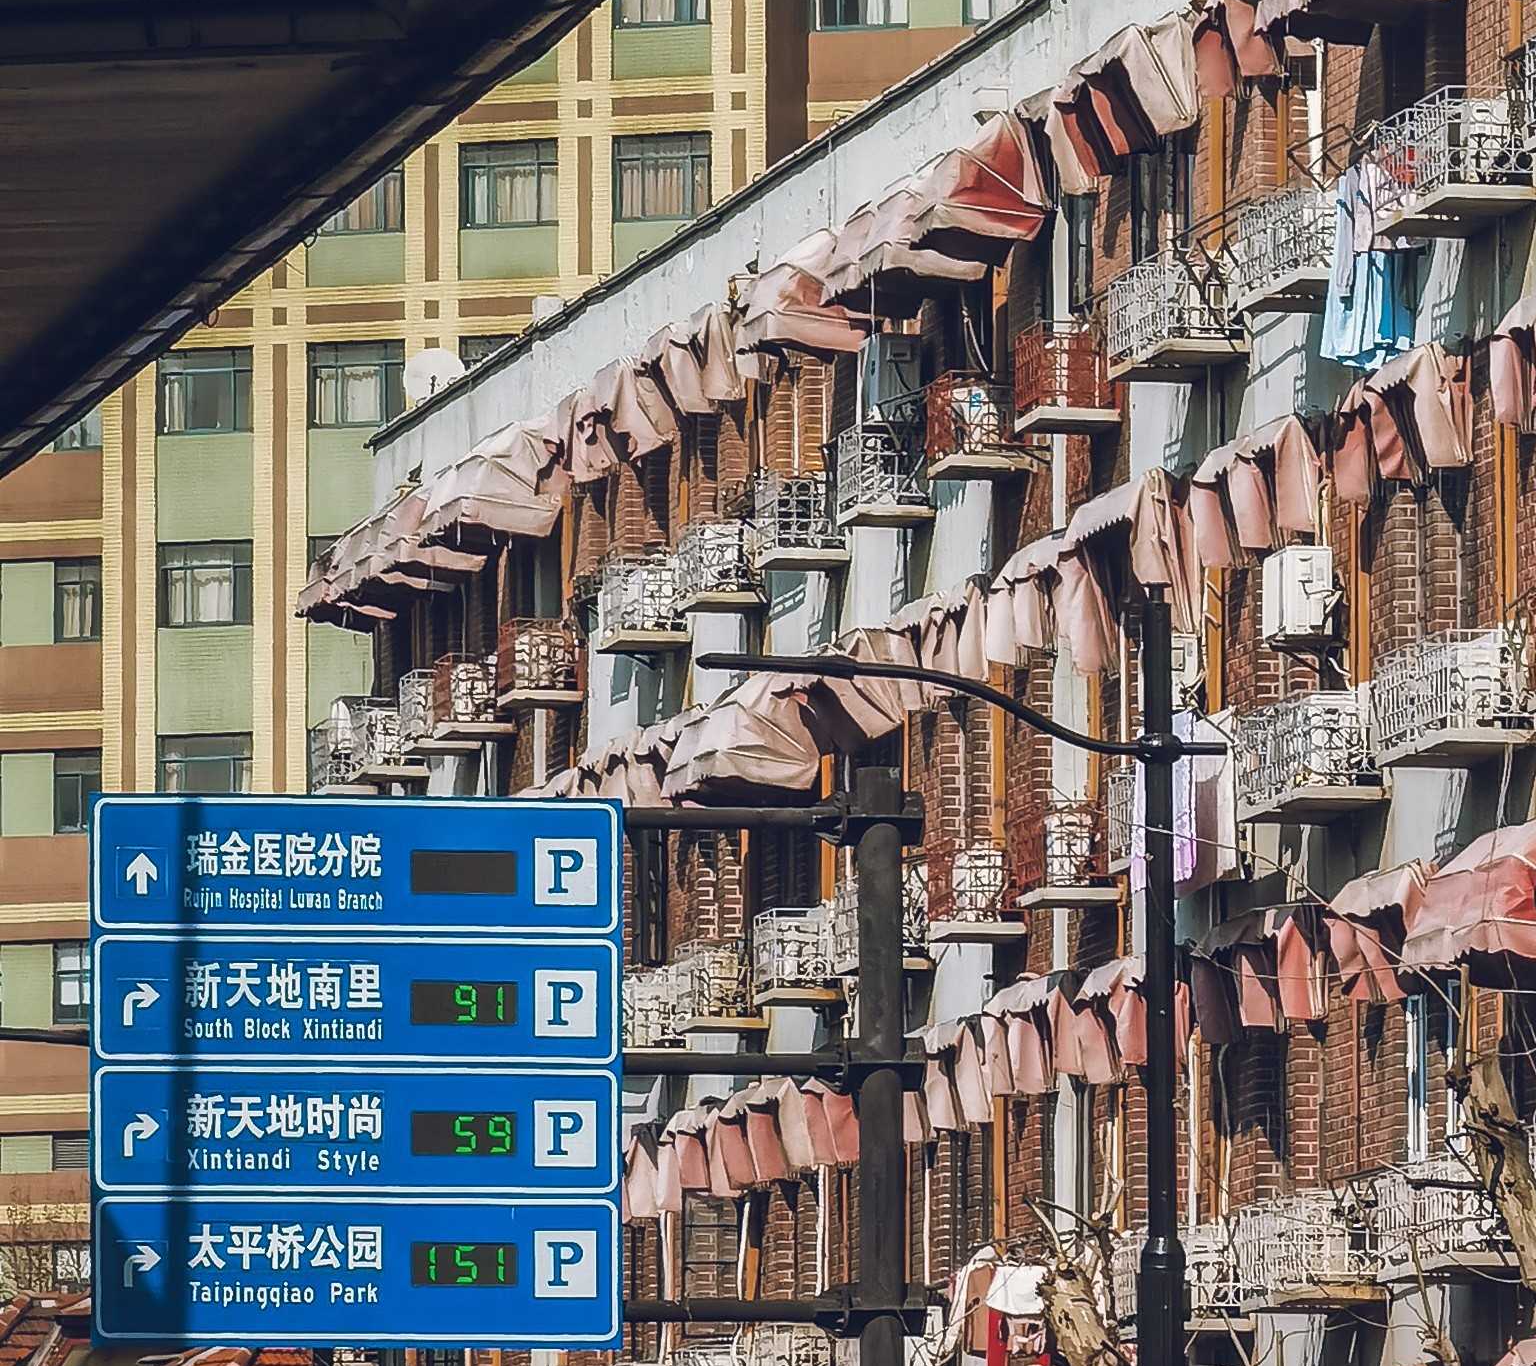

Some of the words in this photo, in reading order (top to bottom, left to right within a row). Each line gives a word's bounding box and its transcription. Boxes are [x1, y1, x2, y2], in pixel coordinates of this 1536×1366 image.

[187, 833, 382, 878] 瑞金医院分院
[547, 849, 584, 894] P
[184, 888, 222, 915] Ruijin
[229, 887, 283, 913] Hospital
[290, 888, 331, 909] Luwan
[338, 888, 383, 911] Branch
[186, 962, 383, 1010] 新天地南里
[453, 985, 505, 1023] 91
[547, 981, 584, 1026] P
[184, 1018, 233, 1039] South
[244, 1018, 291, 1040] Block
[303, 1019, 383, 1041] Xintiandi
[187, 1094, 383, 1140] 新天地时尚
[453, 1115, 512, 1155] 59
[547, 1111, 584, 1156] P
[187, 1147, 291, 1171] Xintiandi
[317, 1149, 380, 1176] Style
[187, 1224, 383, 1270] 太平桥公园
[427, 1245, 506, 1285] 151
[547, 1242, 584, 1287] P
[189, 1281, 314, 1310] Taipingqiao
[330, 1282, 378, 1304] Park
